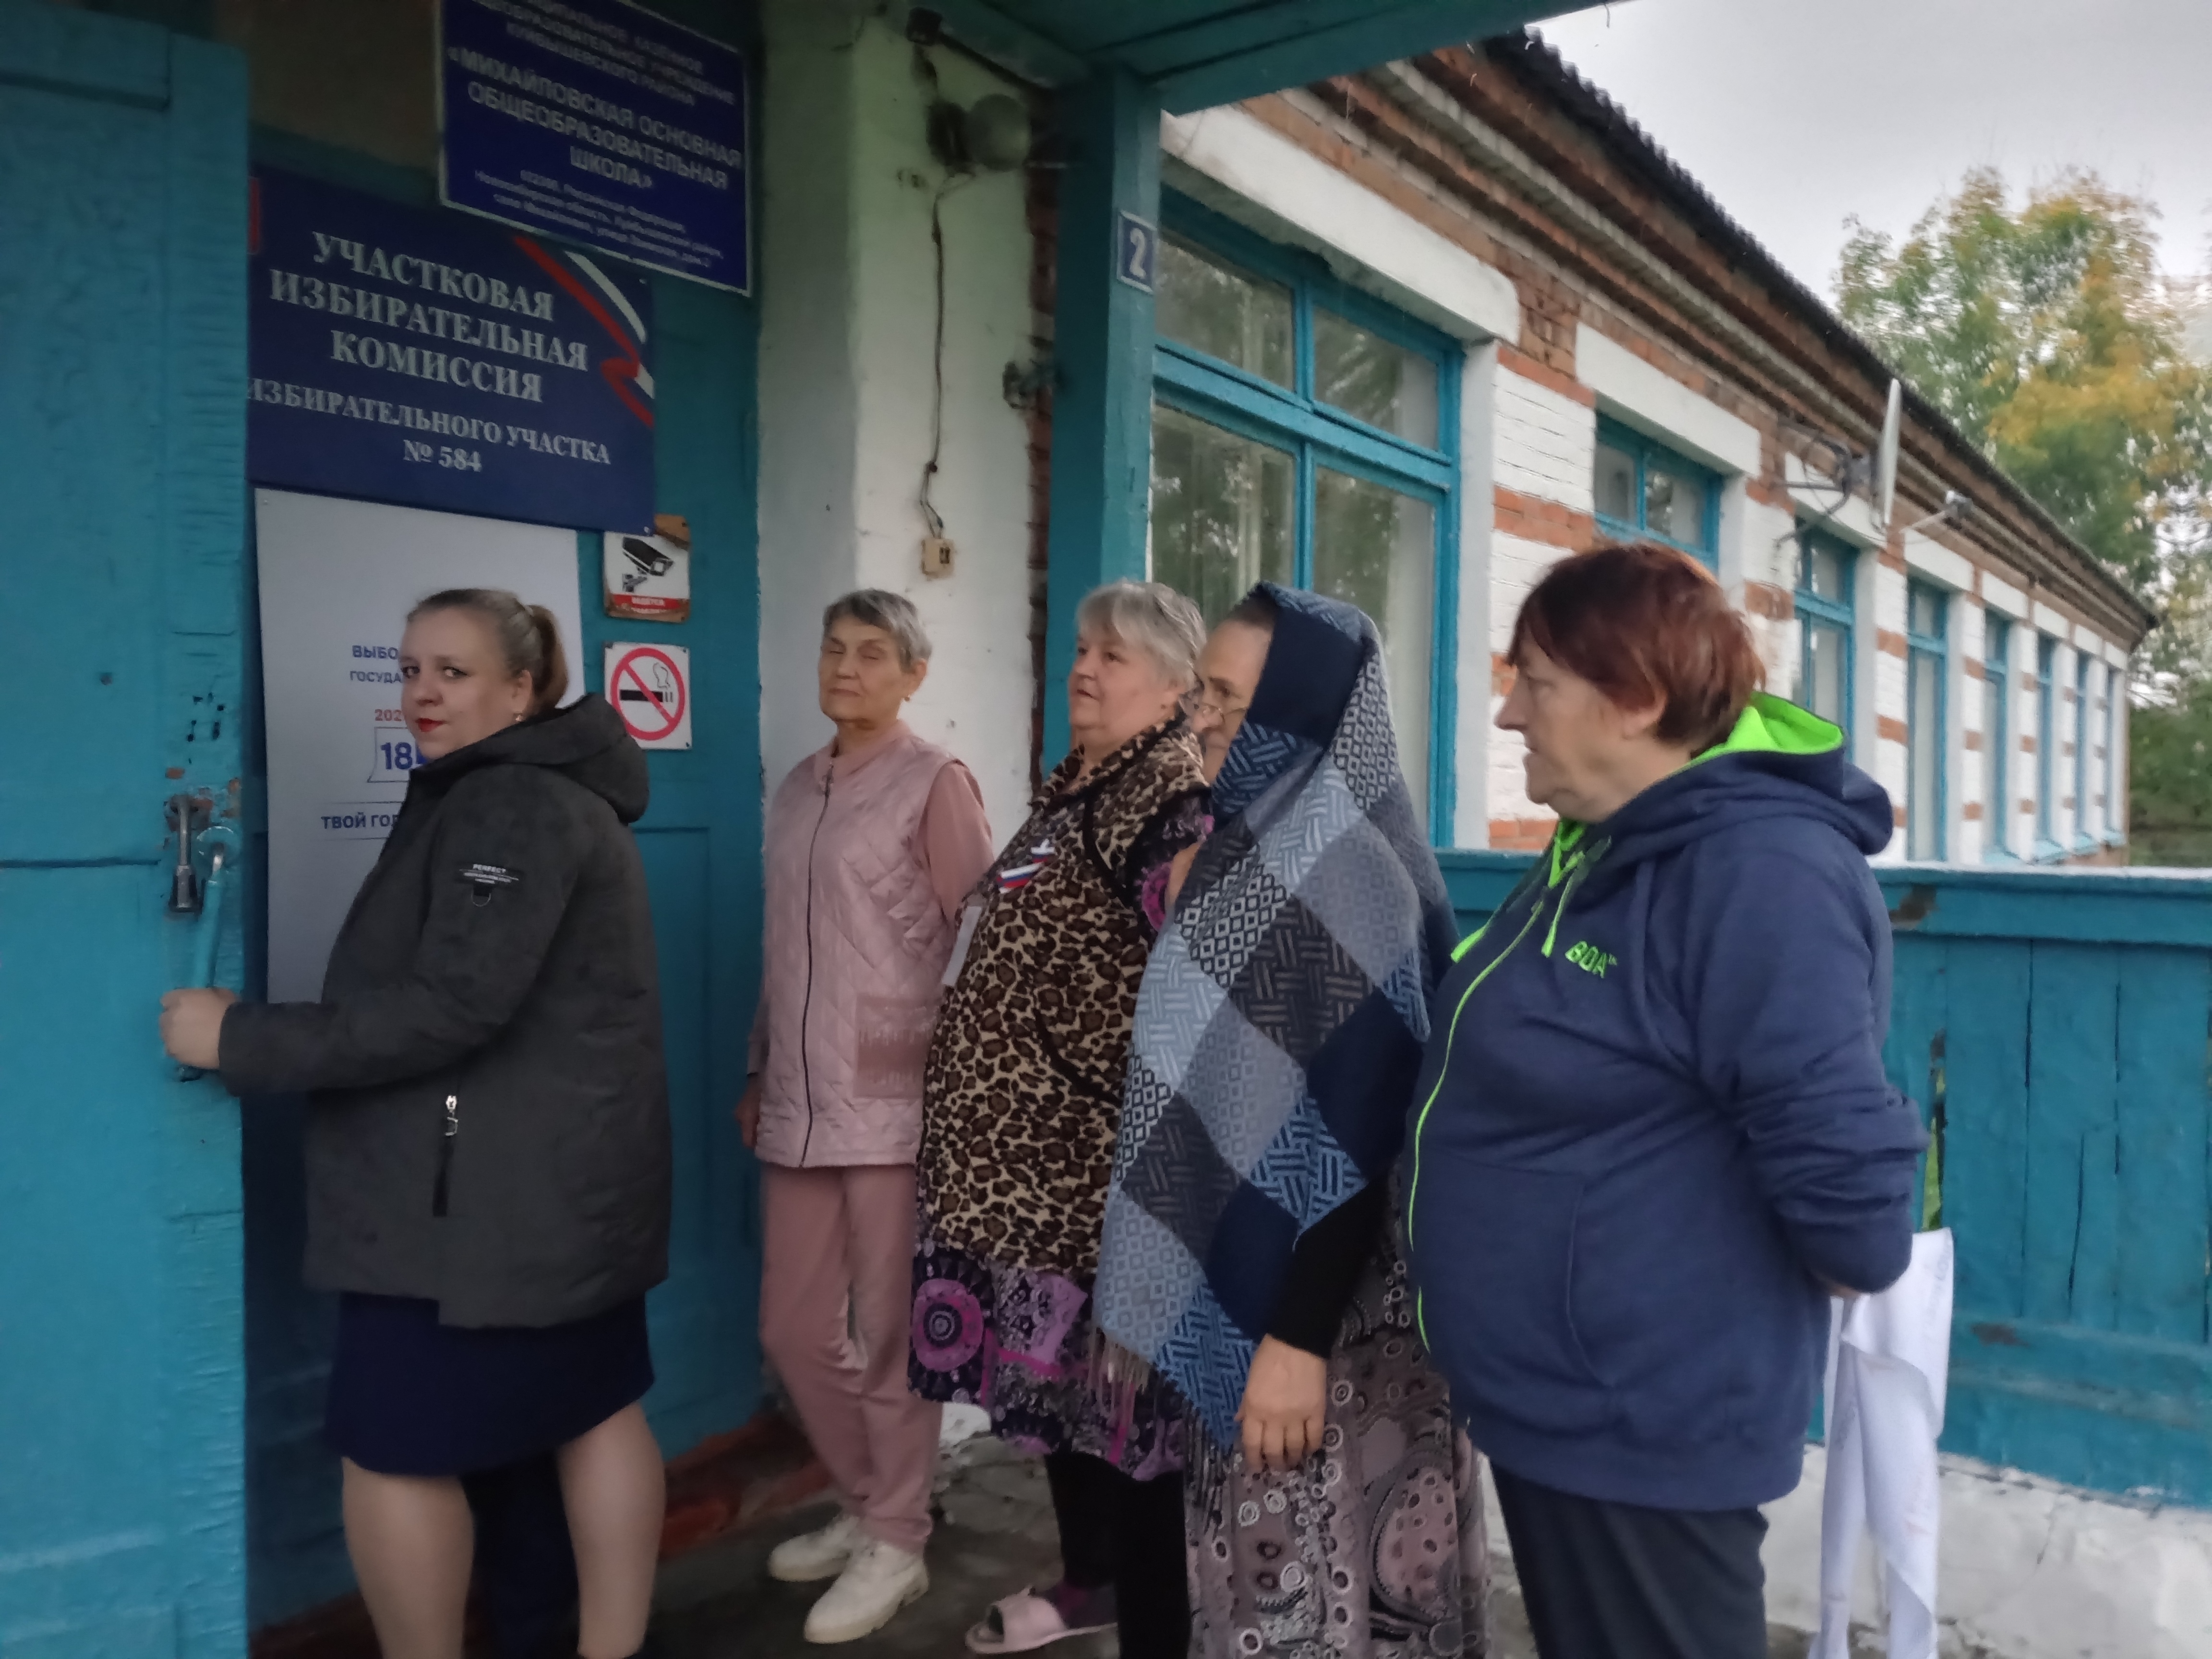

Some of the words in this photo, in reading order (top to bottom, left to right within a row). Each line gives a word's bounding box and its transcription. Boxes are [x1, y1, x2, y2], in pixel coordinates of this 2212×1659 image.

[468, 81, 728, 190] ОБЩЕОБРАЗОВАТЕЛЬНАЯ
[639, 115, 742, 167] ОСНОВНАЯ
[569, 145, 653, 189] ШКОЛА»
[1129, 227, 1147, 279] 2
[312, 231, 554, 322] УЧАСТКОВАЯ
[269, 268, 588, 372] ИЗБИРАТЕЛЬНАЯ
[330, 329, 543, 403] КОМИССИЯ
[403, 439, 433, 463] №
[438, 445, 482, 473] 584
[505, 425, 611, 465] УЧАСТКА
[352, 645, 399, 660] ВЫБО
[350, 671, 402, 684] ГОСУДА
[374, 709, 402, 721] 202
[380, 742, 413, 770] 18
[321, 812, 366, 829] ТВОЙ
